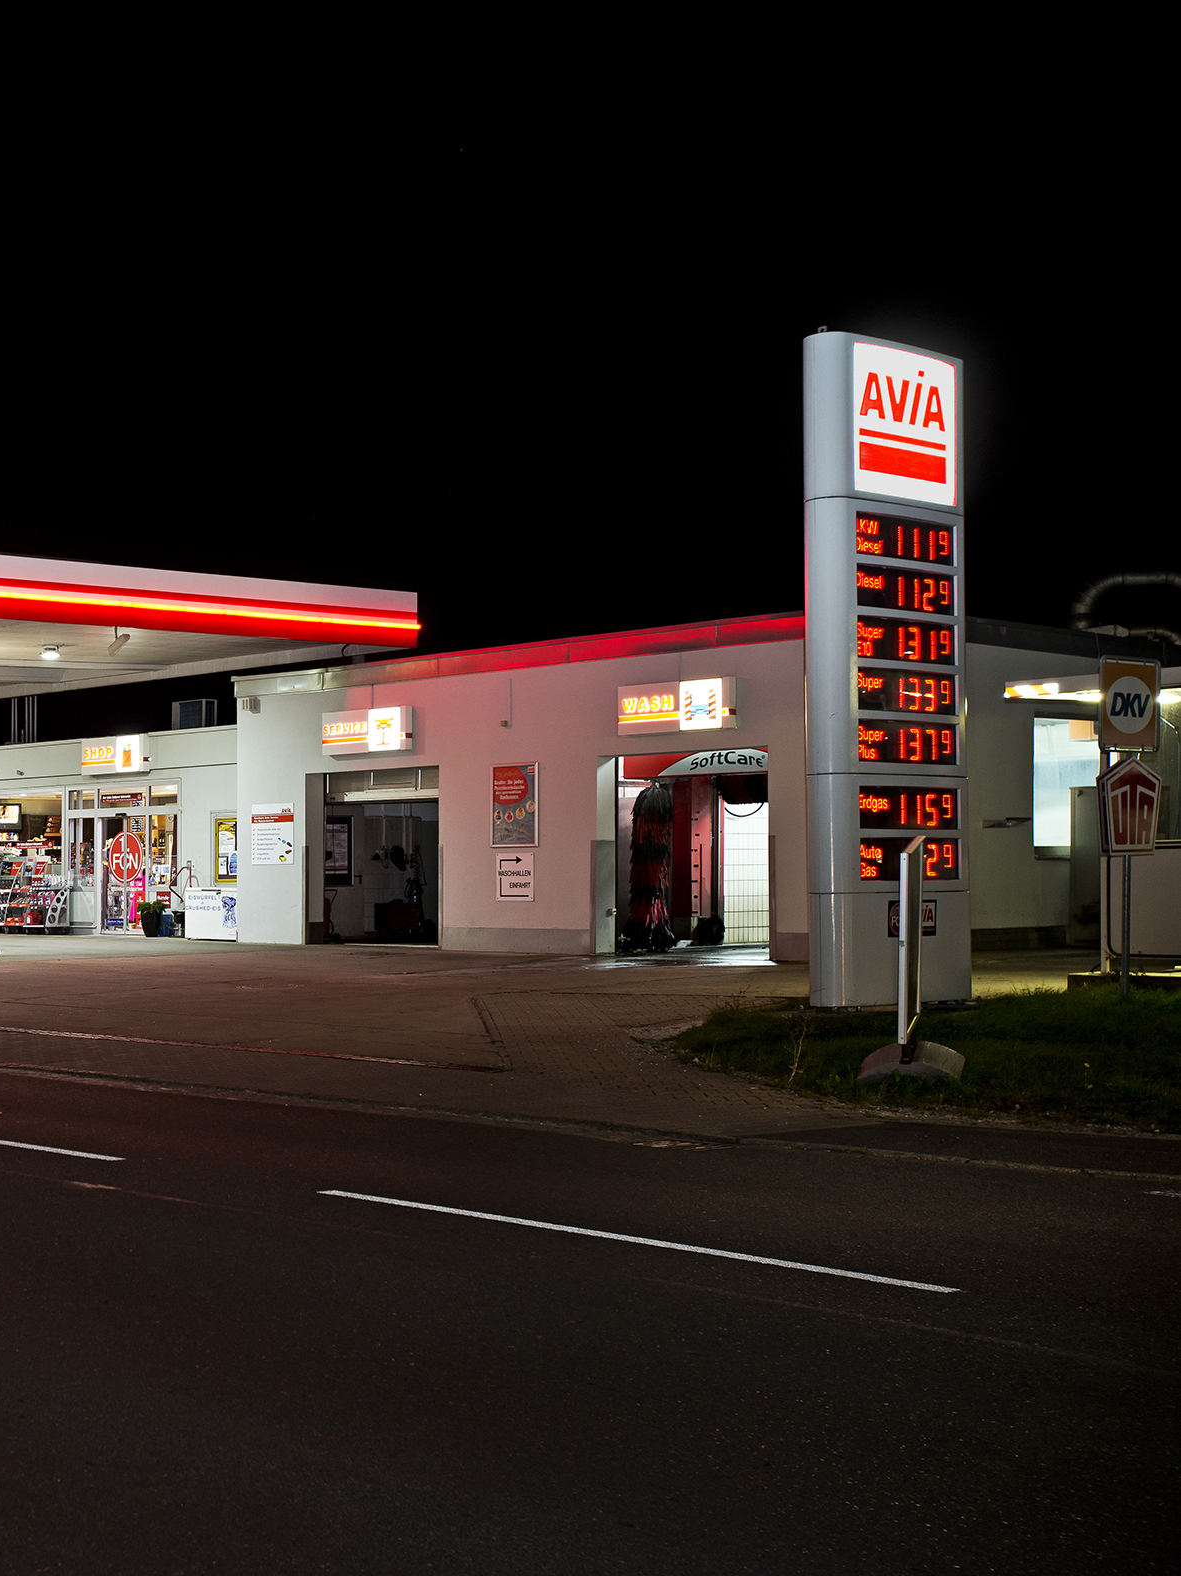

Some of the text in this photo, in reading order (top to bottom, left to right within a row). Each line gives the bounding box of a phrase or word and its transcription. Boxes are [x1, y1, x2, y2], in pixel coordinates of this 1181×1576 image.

[856, 536, 884, 554] Diesel
[856, 571, 884, 589] Diesel
[857, 622, 885, 641] Super
[857, 641, 874, 657] E10
[857, 672, 885, 691] Super
[622, 695, 674, 714] WASH
[1110, 692, 1151, 718] DKV
[322, 721, 368, 735] SERVICE
[858, 725, 886, 744] Super
[83, 746, 114, 759] SHOP
[858, 744, 879, 760] Plus
[858, 794, 890, 812] Erdgas
[112, 853, 139, 870] FCN
[498, 869, 532, 877] WASCHHALLEN
